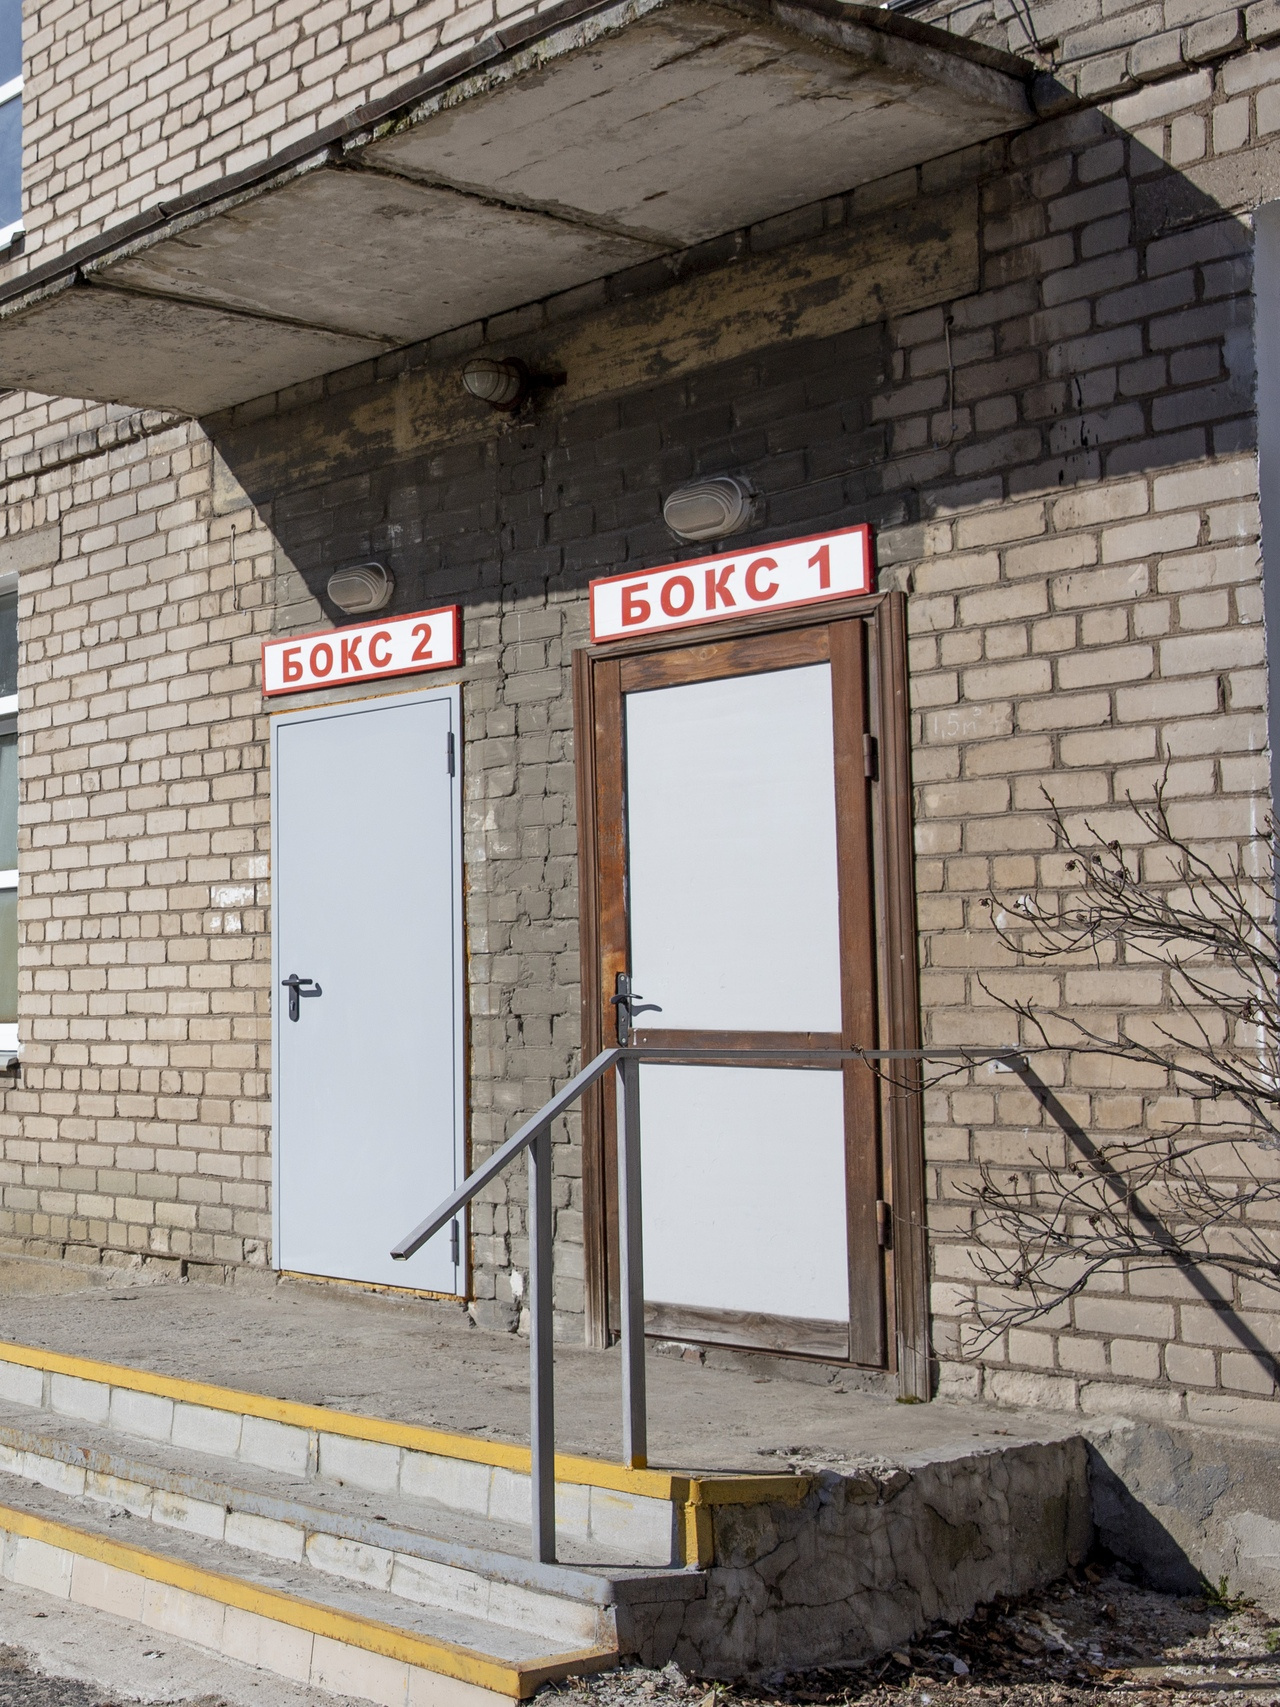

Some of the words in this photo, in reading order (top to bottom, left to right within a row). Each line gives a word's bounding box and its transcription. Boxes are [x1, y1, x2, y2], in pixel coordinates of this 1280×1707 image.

[621, 557, 780, 627] БОКС
[808, 544, 831, 590] 1
[282, 631, 393, 683] БОКС
[411, 623, 433, 662] 2
